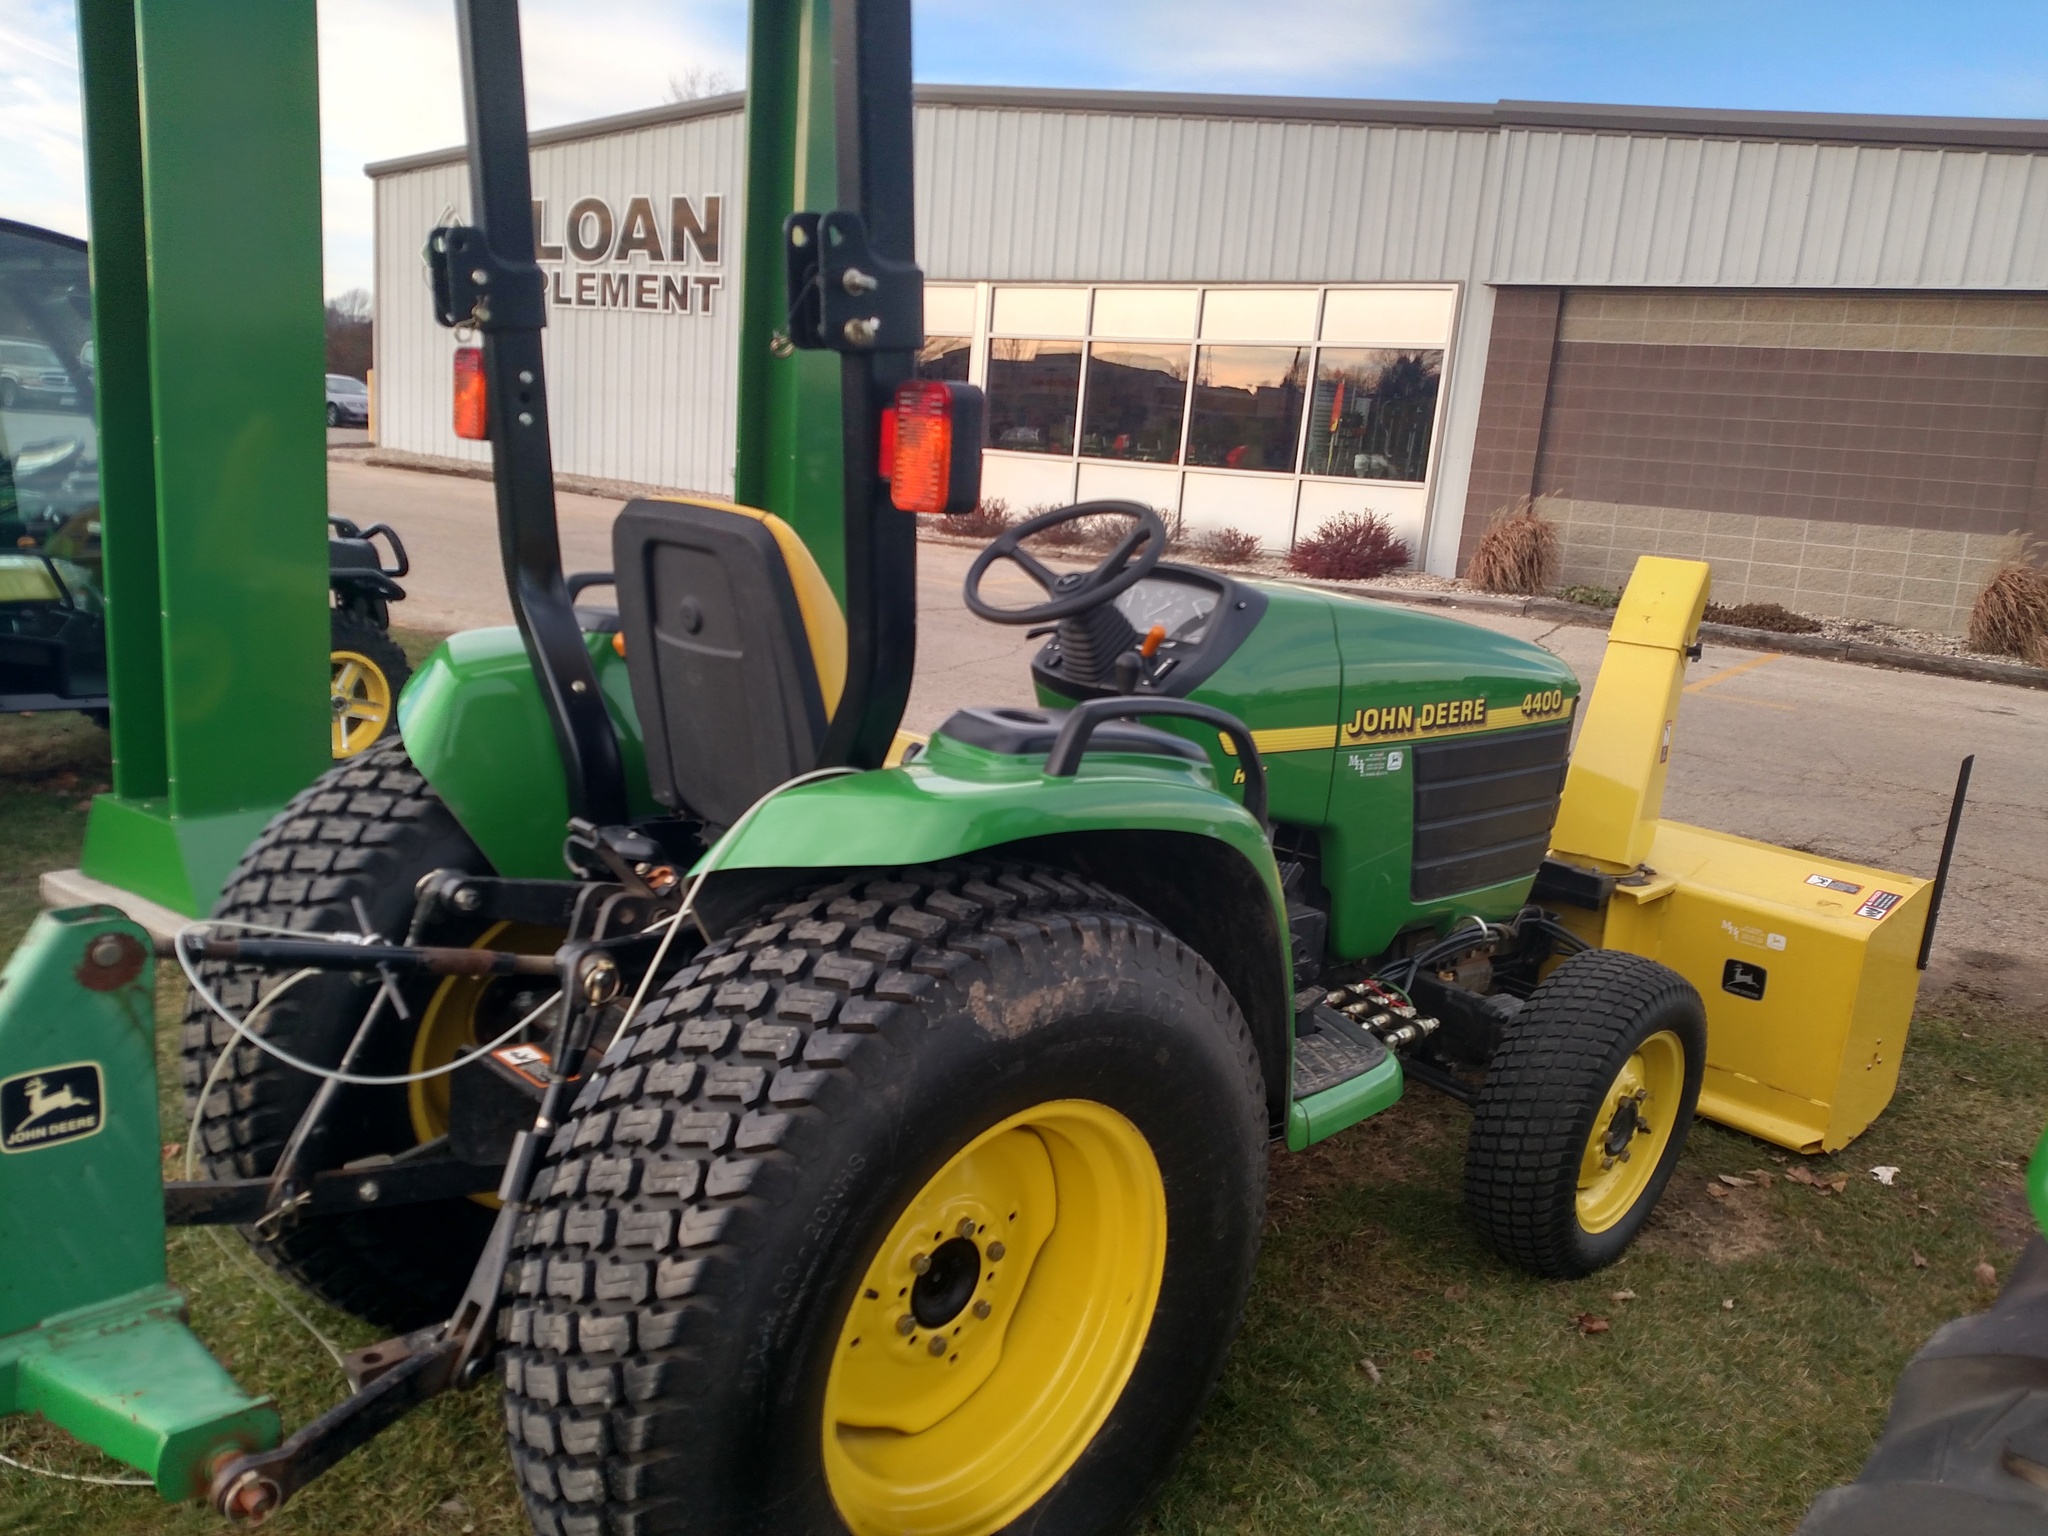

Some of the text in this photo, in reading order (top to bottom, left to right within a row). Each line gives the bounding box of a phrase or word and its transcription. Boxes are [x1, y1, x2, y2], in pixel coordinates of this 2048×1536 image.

[532, 194, 721, 265] LOAN
[543, 270, 721, 315] LEMENT
[1347, 689, 1562, 736] JOHN DEERE 4400
[7, 1116, 95, 1145] JOHN DEERE
